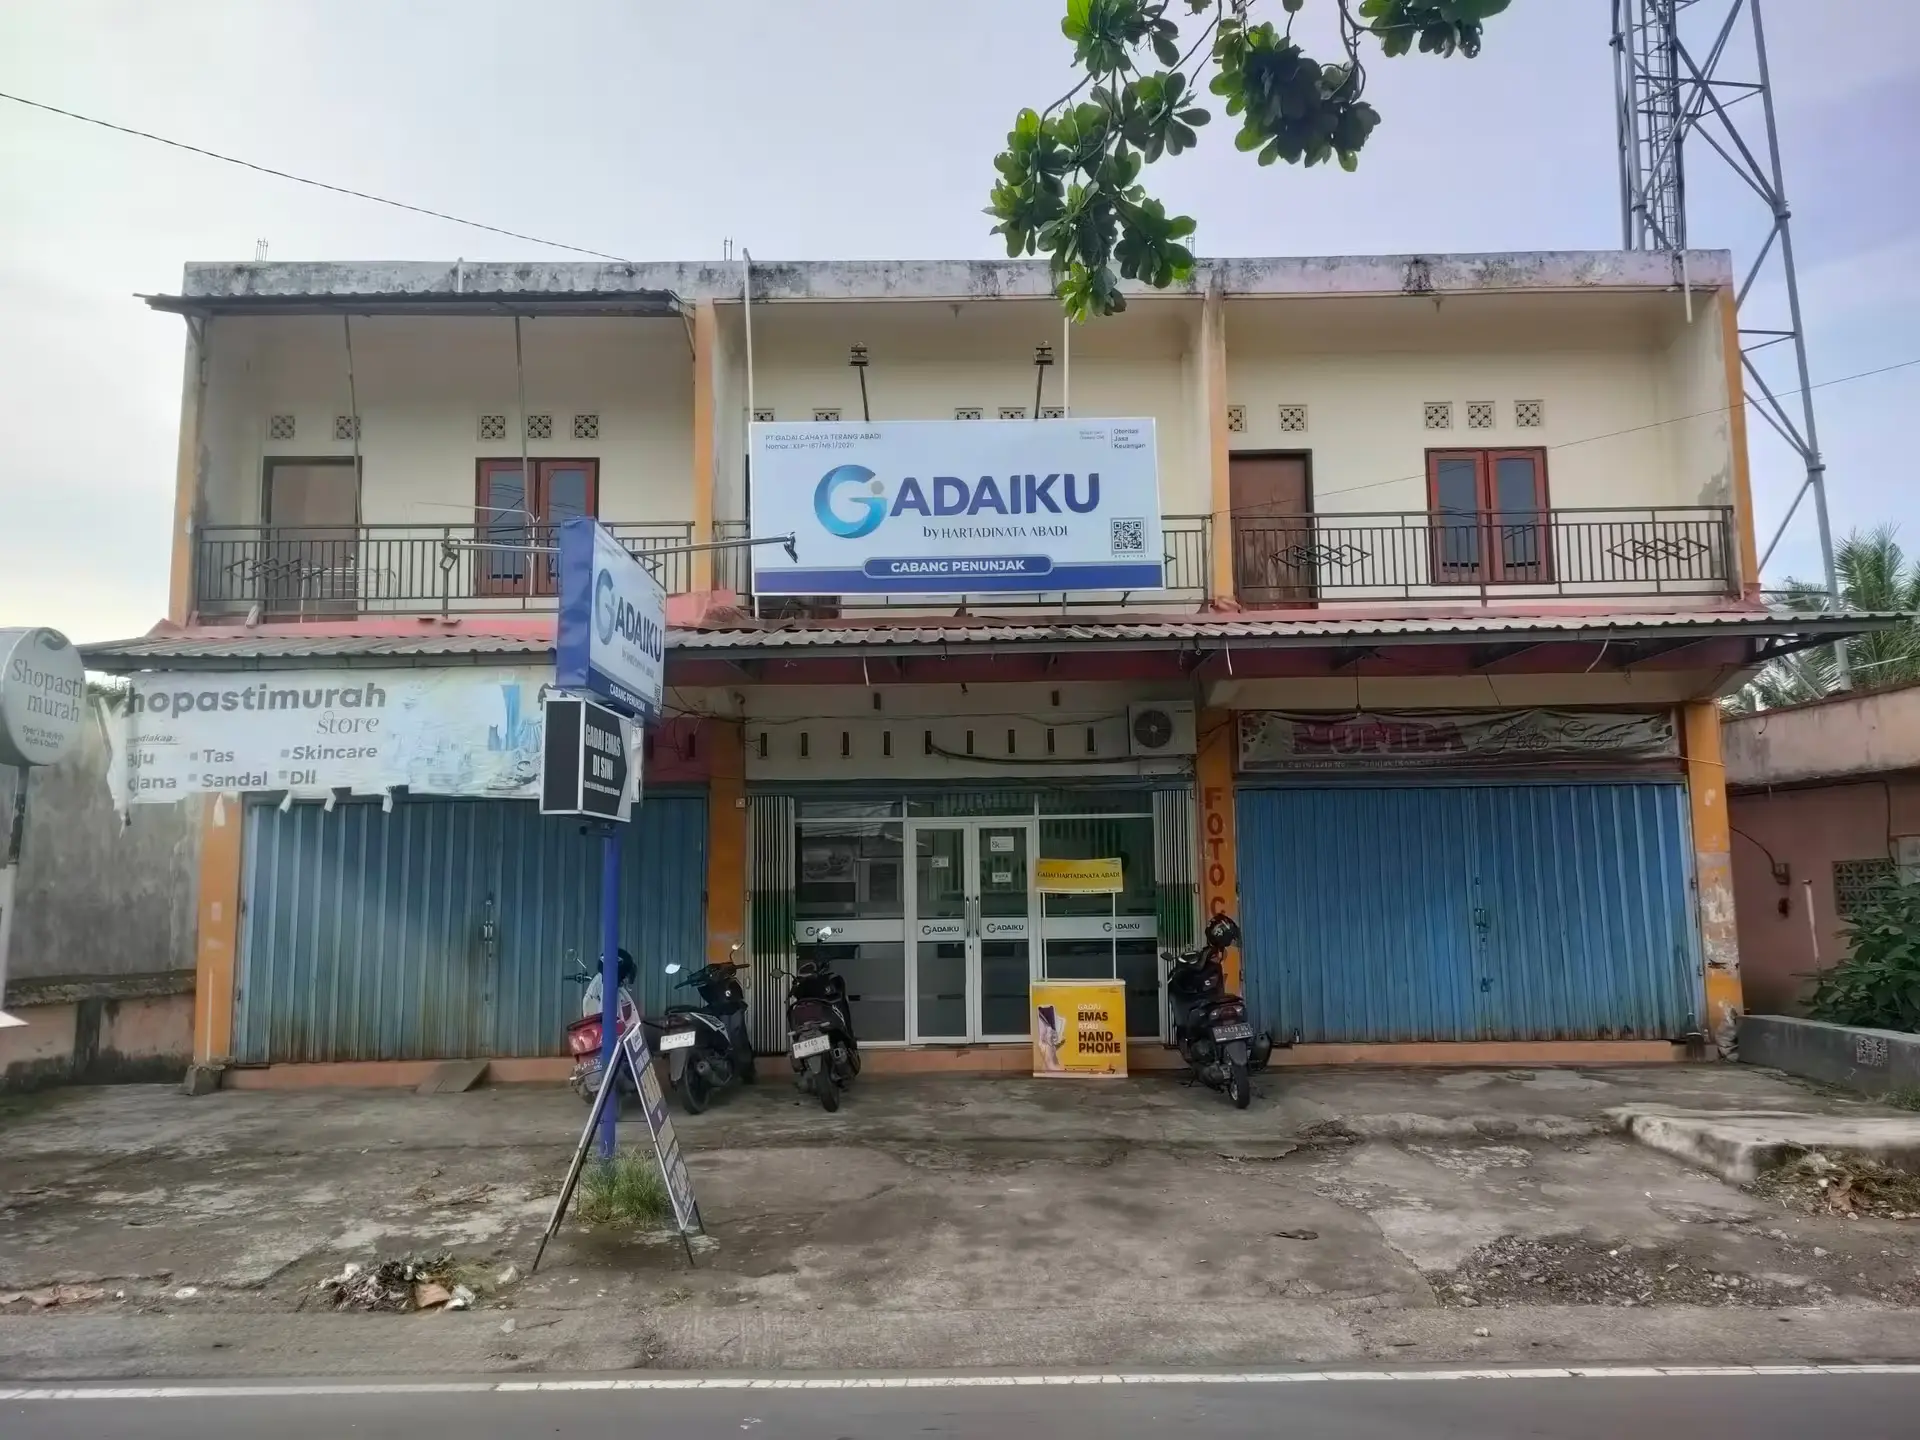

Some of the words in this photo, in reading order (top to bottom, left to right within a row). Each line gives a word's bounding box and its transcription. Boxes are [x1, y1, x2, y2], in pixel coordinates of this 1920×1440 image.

[813, 464, 1101, 539] GADAIKU
[923, 526, 939, 540] by
[942, 526, 1027, 538] HARTADINATA
[1029, 525, 1068, 536] ABADI
[890, 561, 949, 573] CABANG
[952, 559, 1025, 572] PENUNJAK
[595, 568, 662, 663] GADAIKU
[12, 658, 84, 699] Shopasti
[27, 694, 79, 722] murah
[316, 711, 380, 734] store
[585, 723, 605, 752] GADAI
[604, 731, 621, 757] EMAS
[203, 749, 235, 763] Tas
[292, 745, 378, 760] Skincare
[592, 754, 600, 777] DI
[600, 757, 614, 780] SINI
[201, 771, 268, 788] Sandal
[290, 770, 316, 785] Dll
[1205, 787, 1225, 886] FOTO
[922, 925, 960, 935] GADAIKU
[986, 923, 1024, 933] GADAIKU
[1077, 1011, 1109, 1021] EMAS
[1078, 1022, 1099, 1030] ATAU
[1078, 1031, 1114, 1042] HAND
[1078, 1042, 1121, 1053] PHONE
